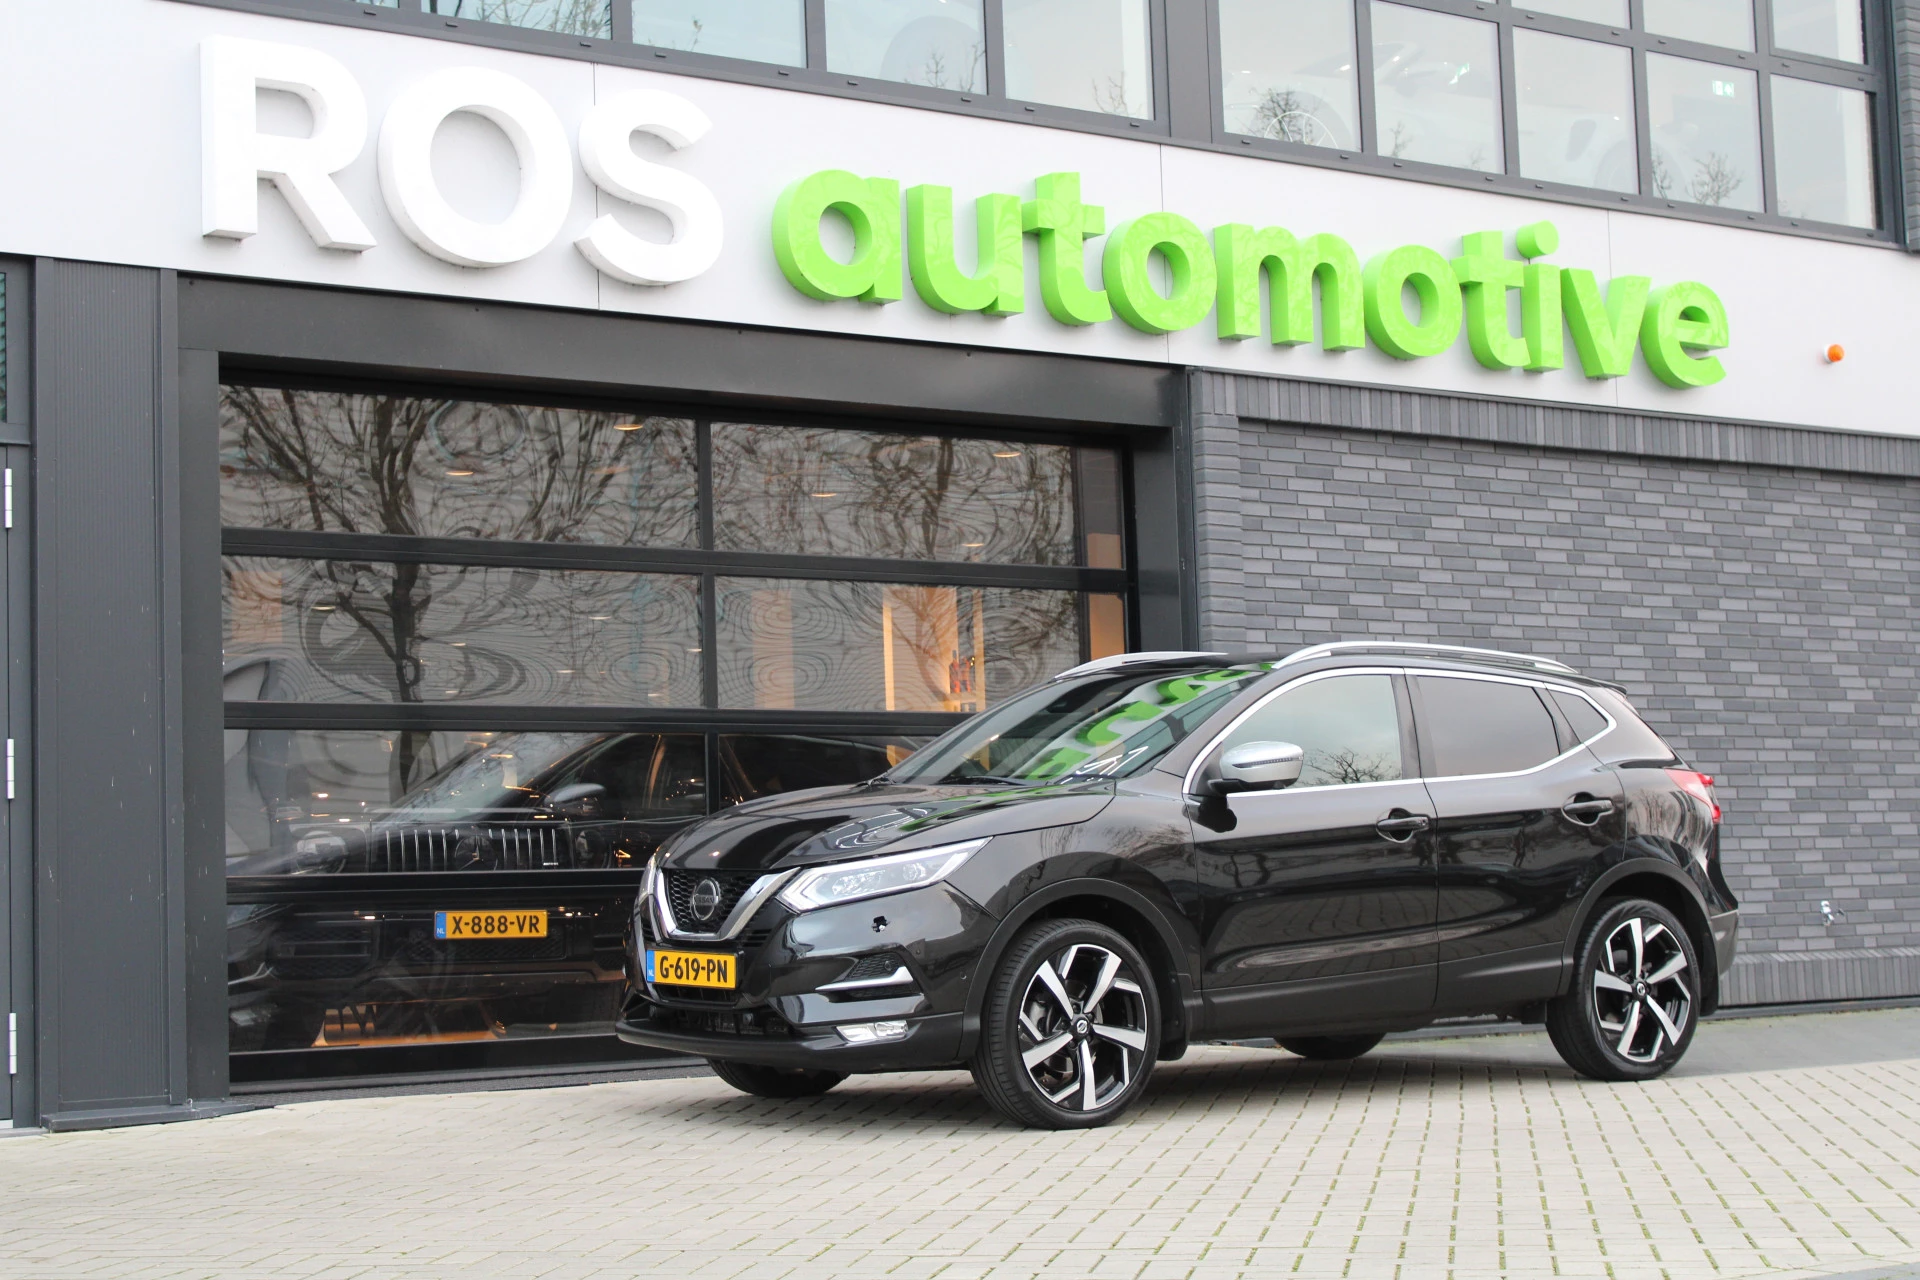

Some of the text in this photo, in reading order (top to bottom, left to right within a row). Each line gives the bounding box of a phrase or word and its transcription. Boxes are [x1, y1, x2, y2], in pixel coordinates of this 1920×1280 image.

[200, 34, 1729, 389] ROS automotive
[452, 916, 540, 934] X-888-VR
[660, 956, 727, 983] G-619-PN
